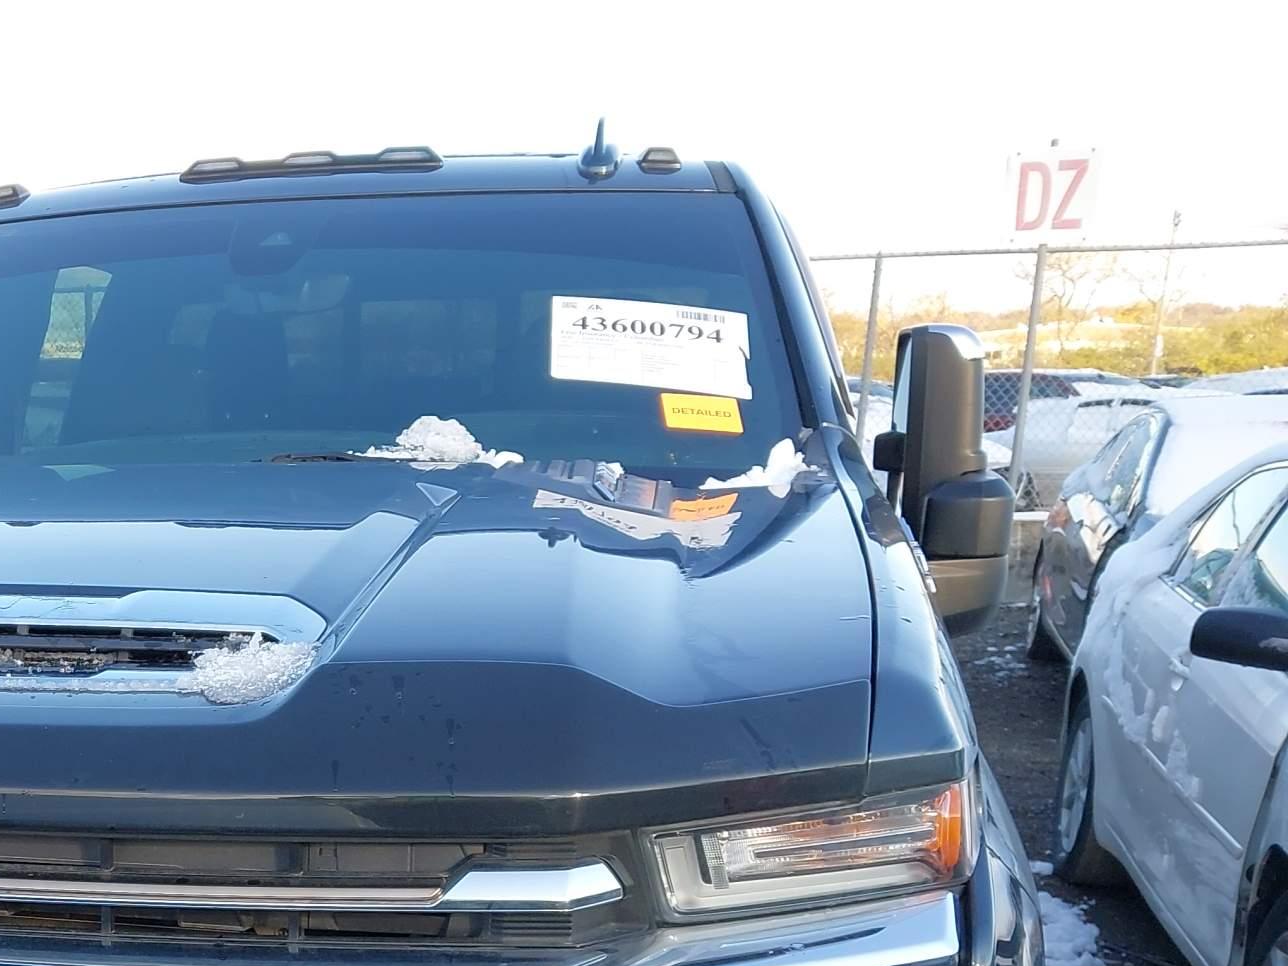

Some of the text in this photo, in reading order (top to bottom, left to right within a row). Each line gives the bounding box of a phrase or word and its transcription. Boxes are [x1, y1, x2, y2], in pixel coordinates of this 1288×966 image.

[1015, 158, 1090, 231] DZ
[571, 315, 725, 344] 43600794
[671, 406, 732, 419] DETAILED
